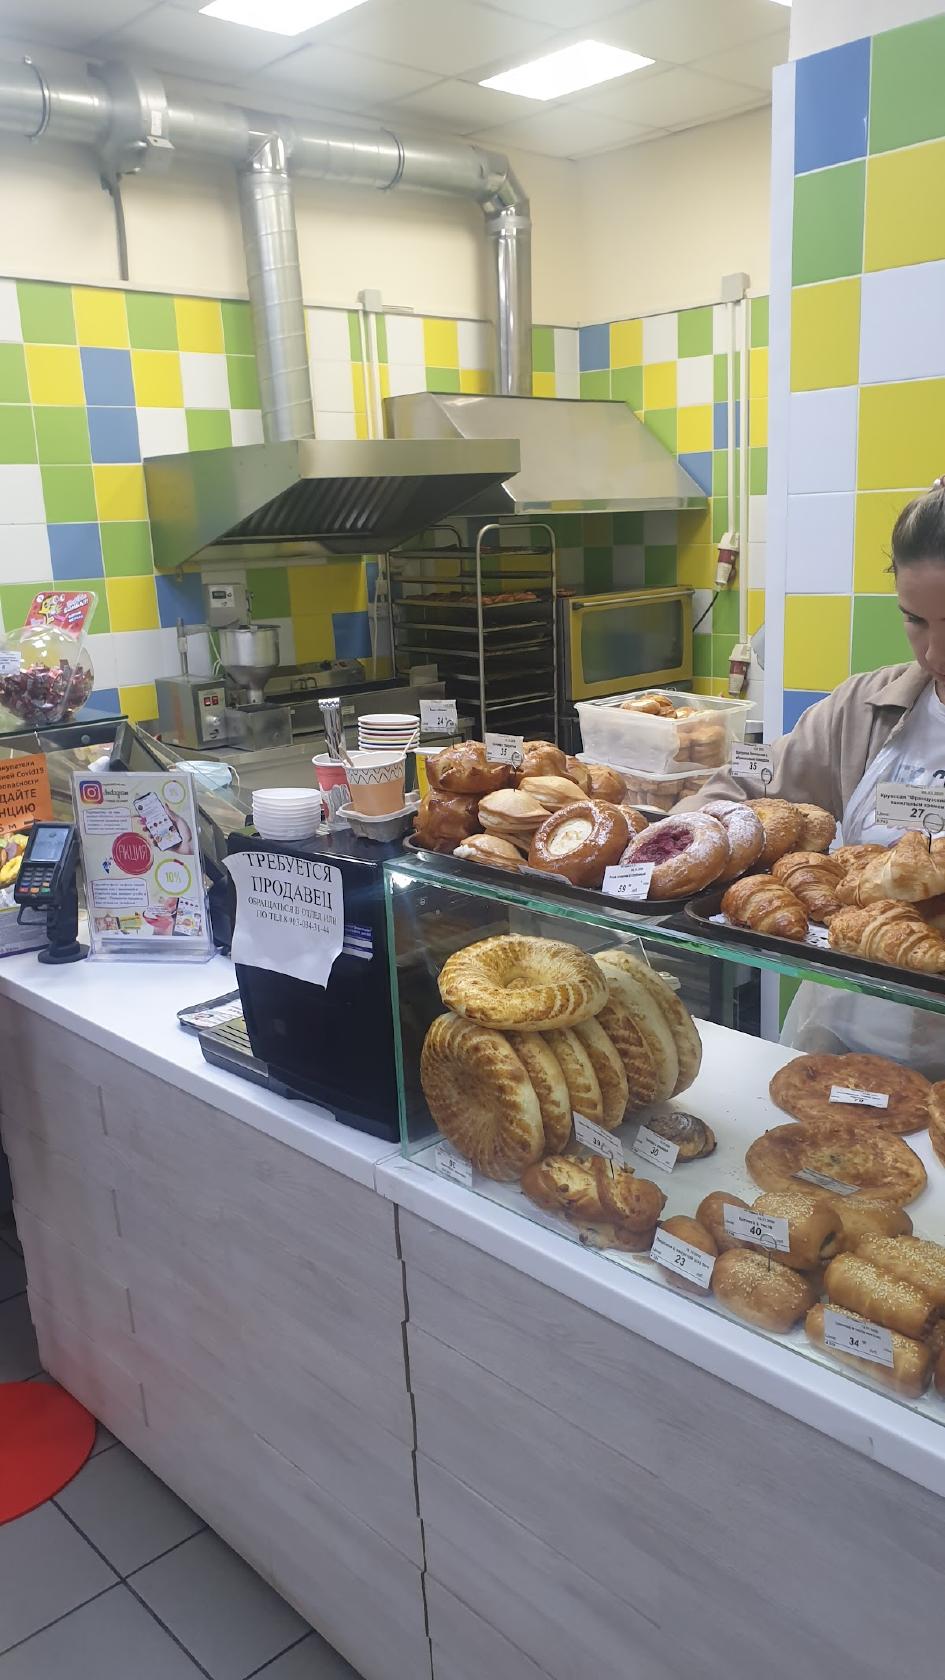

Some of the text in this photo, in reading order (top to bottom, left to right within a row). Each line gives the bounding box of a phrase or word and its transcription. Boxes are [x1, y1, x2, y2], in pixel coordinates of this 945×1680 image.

[909, 807, 925, 818] 27
[118, 843, 149, 861] АКЦИЯ
[242, 852, 333, 883] ТРЕБУЕТСЯ
[165, 871, 182, 883] 10%
[250, 876, 333, 911] ПРОДАВЕЦ
[247, 896, 294, 914] ОБРАЩАТЬСЯ
[256, 909, 268, 919] ПО
[749, 1226, 762, 1236] 40
[674, 1254, 686, 1267] 23
[849, 1336, 860, 1347] 34
